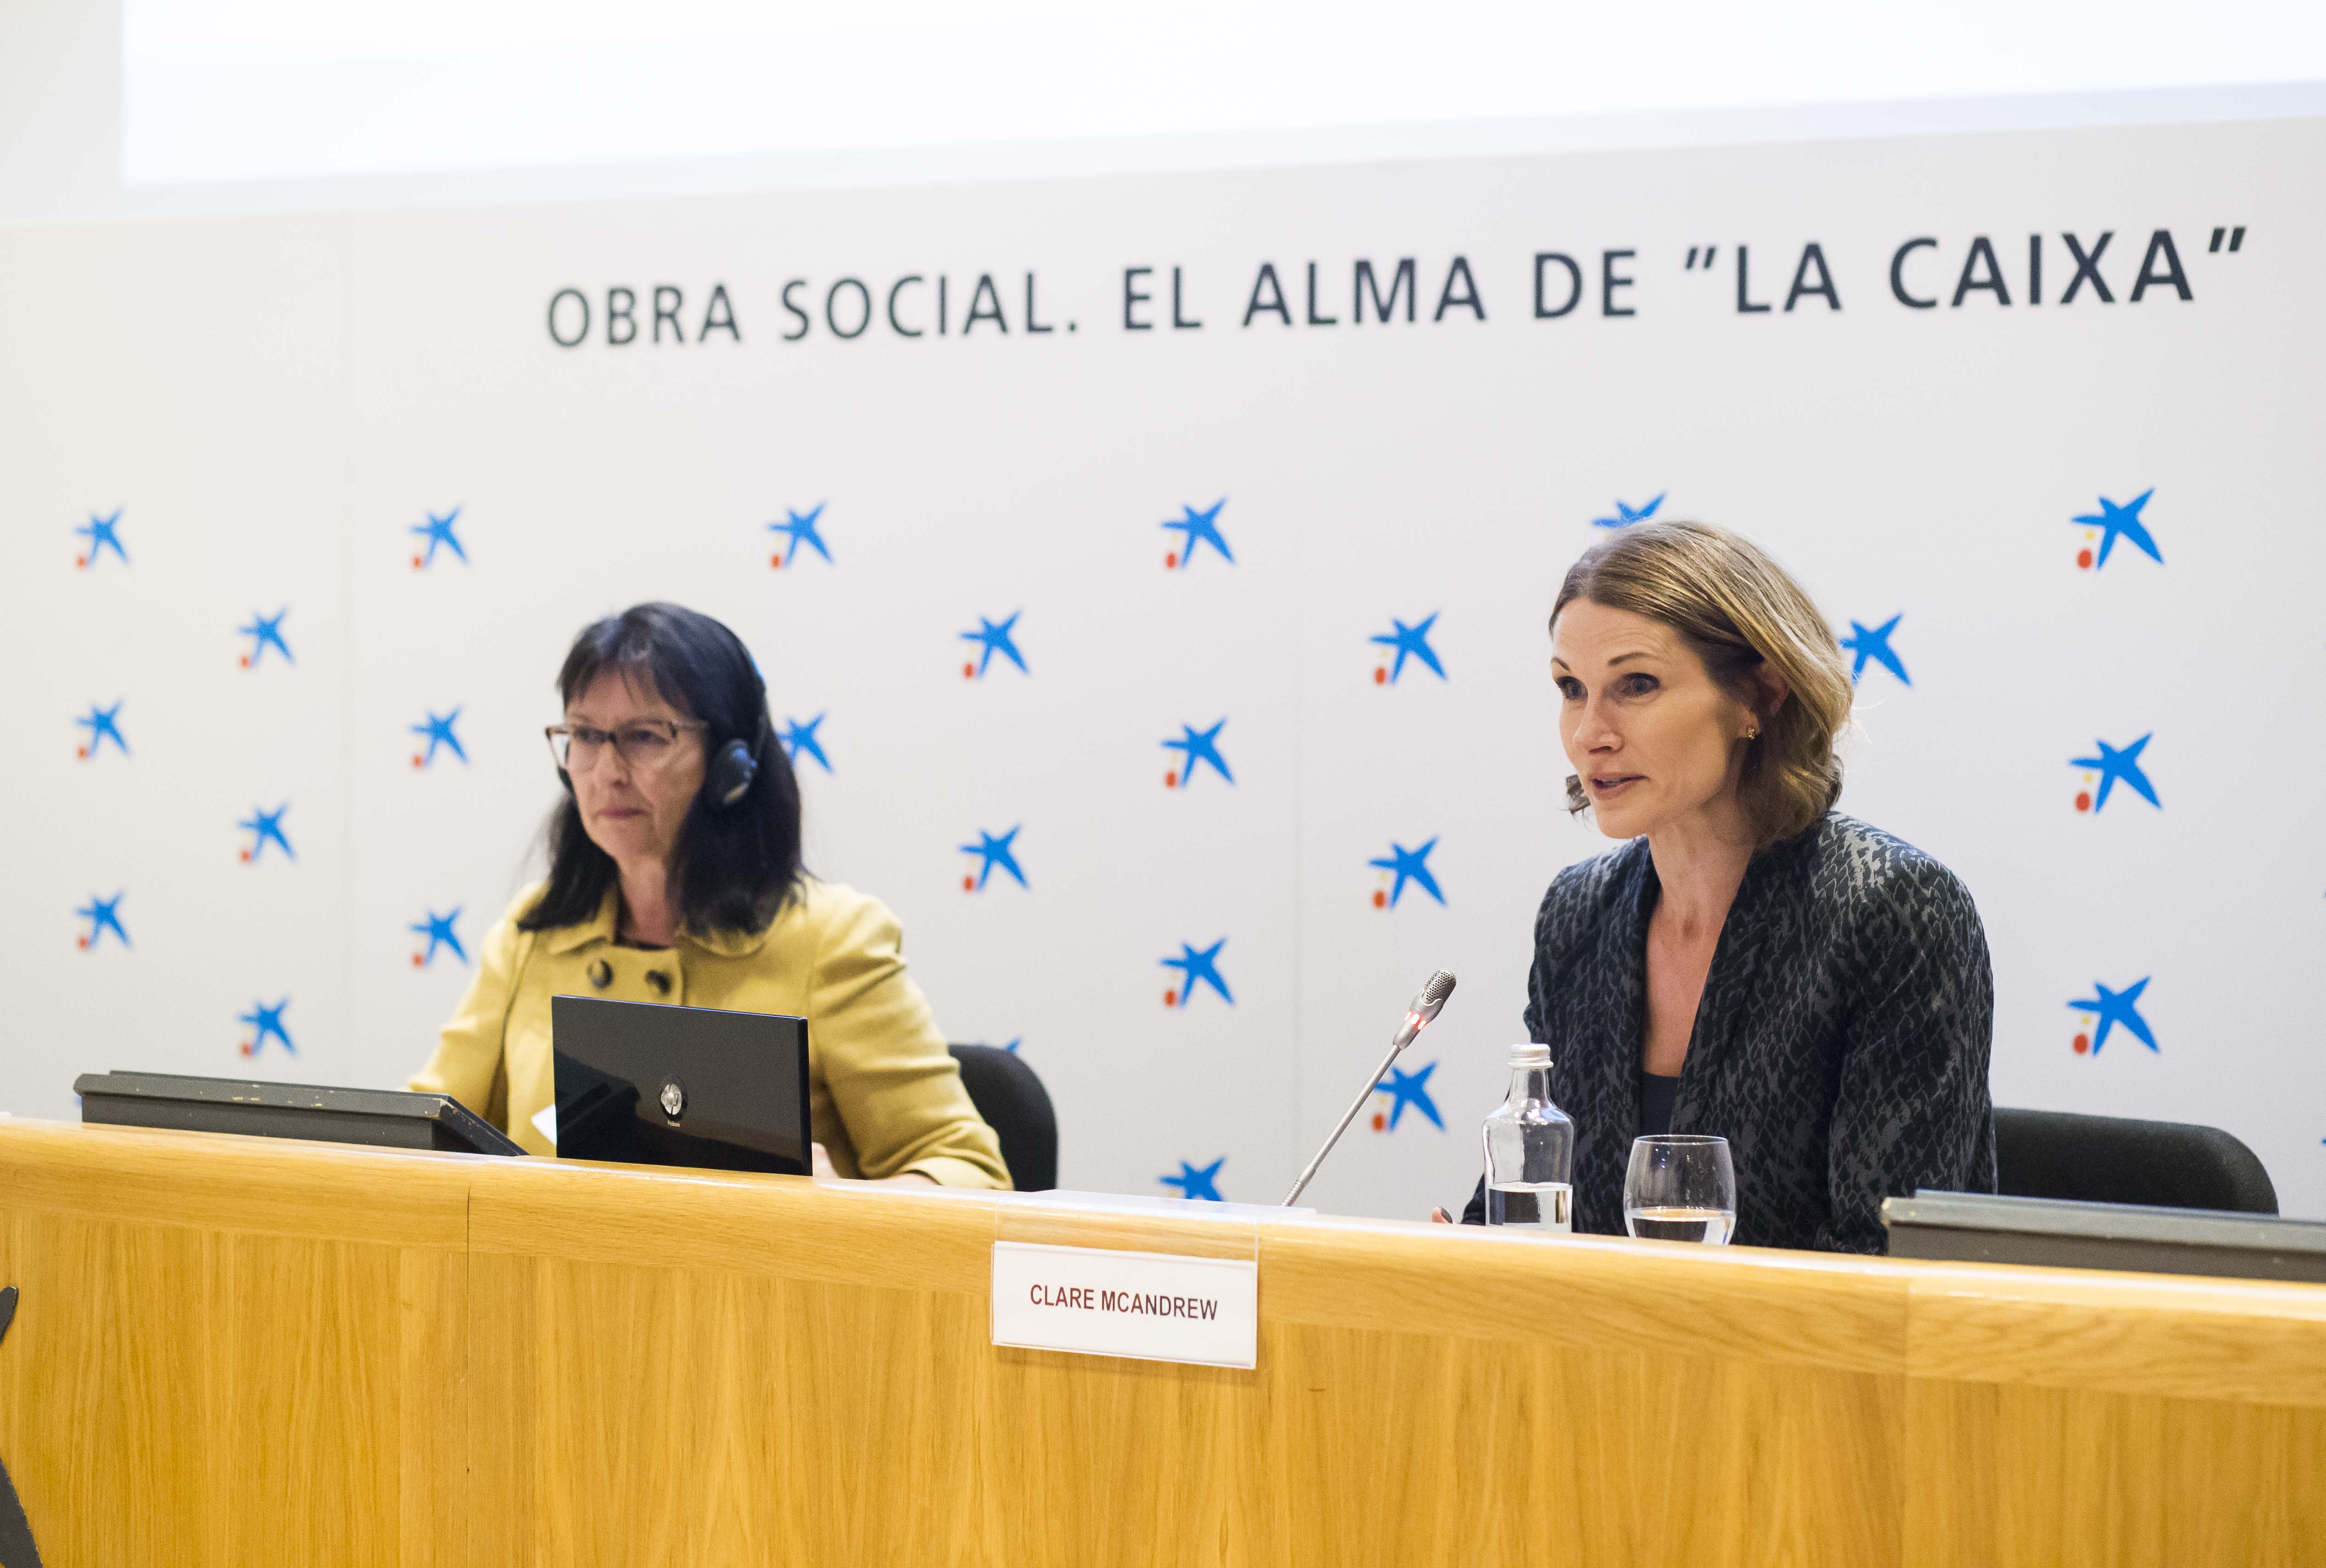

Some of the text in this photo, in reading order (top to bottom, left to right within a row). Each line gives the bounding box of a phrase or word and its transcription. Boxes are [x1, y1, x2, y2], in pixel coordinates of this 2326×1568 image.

[547, 283, 741, 349] OBRA
[780, 272, 1077, 342] SOCIAL.
[1123, 266, 1203, 331] EL
[1242, 255, 1487, 328] ALMA
[1533, 248, 1637, 320] DE
[1030, 1284, 1218, 1320] CLARE MCANDREW
